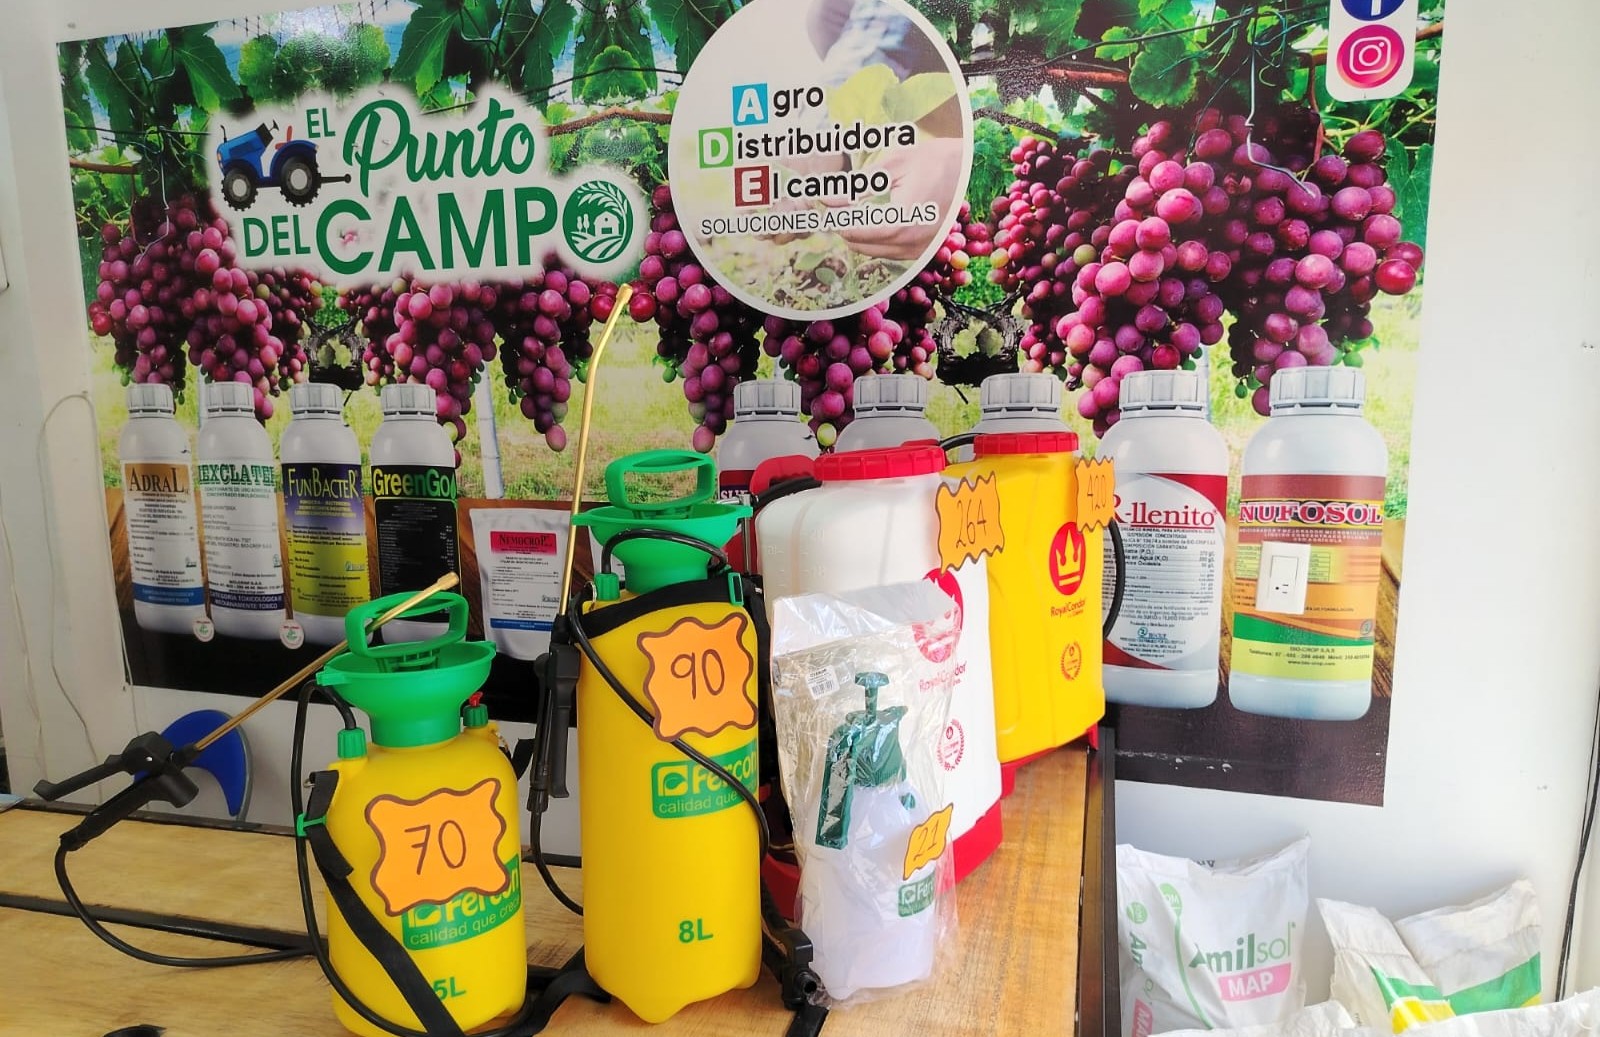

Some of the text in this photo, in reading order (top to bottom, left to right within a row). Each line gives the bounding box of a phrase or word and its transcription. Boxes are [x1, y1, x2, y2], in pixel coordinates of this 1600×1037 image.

[737, 85, 824, 123] Agro
[306, 97, 536, 199] EL Punto
[702, 122, 915, 165] Distribuidora
[786, 170, 889, 202] campo
[242, 215, 311, 257] DEL
[700, 204, 937, 236] SOLUCIONES AGRÍCOLAS
[956, 498, 987, 548] 264
[1239, 501, 1383, 525] NUFOSOL
[671, 648, 725, 700] 90
[658, 789, 738, 814] calidad que
[404, 819, 467, 875] 70
[913, 827, 938, 861] 21
[410, 921, 468, 945] calidad
[472, 913, 497, 932] que
[678, 918, 713, 943] 8L
[433, 976, 467, 1001] 5L
[1228, 971, 1274, 998] MAP
